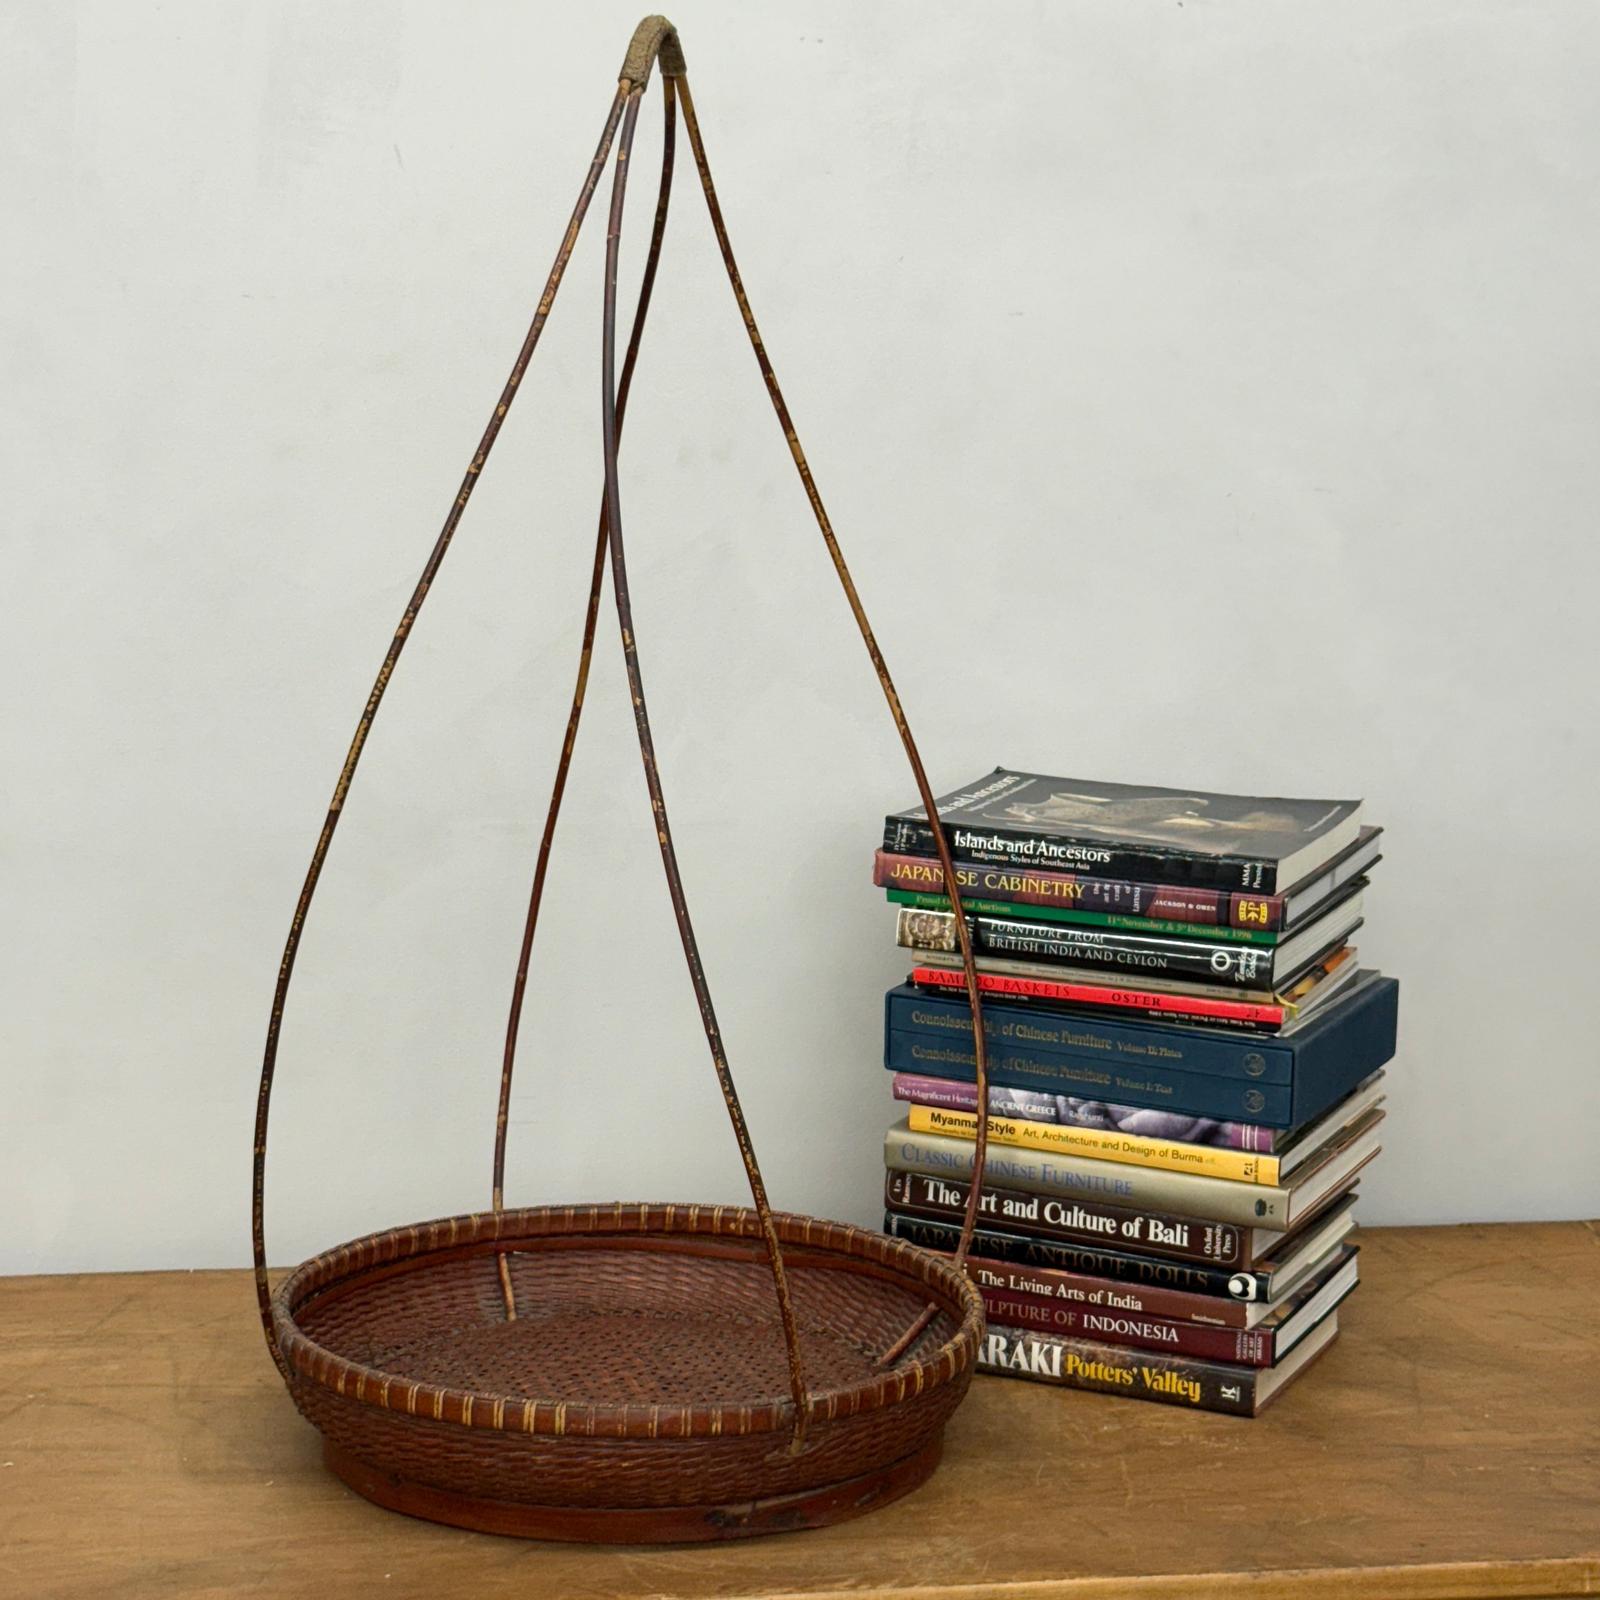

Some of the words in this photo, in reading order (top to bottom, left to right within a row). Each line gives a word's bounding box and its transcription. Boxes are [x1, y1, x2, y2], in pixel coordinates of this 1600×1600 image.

[954, 831, 1004, 852] Islands
[1006, 838, 1034, 855] and
[1036, 840, 1111, 863] Ancestors
[971, 850, 1009, 862] Indigenous
[1010, 854, 1031, 864] Styles
[1032, 857, 1040, 865] of
[1040, 857, 1075, 869] Southeast
[1076, 863, 1090, 871] Asia
[891, 863, 979, 887] JAPANSE
[984, 873, 1086, 899] CABINETRY
[1242, 863, 1250, 887] MMA
[1154, 899, 1186, 909] JACKSON
[990, 923, 1063, 939] FURNITURE
[1067, 932, 1104, 945] FROM
[1122, 918, 1163, 931] November
[1166, 923, 1175, 931] &
[1187, 925, 1229, 938] December
[1231, 929, 1252, 939] 1996
[988, 937, 1039, 953] BRITISH
[1043, 946, 1081, 958] INDIA
[1085, 950, 1113, 962] AND
[1116, 952, 1168, 969] CEYLON
[1003, 980, 1070, 997] BASKETS
[1111, 992, 1161, 1007] OSTER
[1002, 1022, 1014, 1035] of
[1015, 1024, 1058, 1043] Chinese
[1061, 1030, 1112, 1050] Furniture
[1116, 1041, 1146, 1055] Volume
[1002, 1055, 1014, 1069] of
[1014, 1057, 1058, 1077] Chinese
[1061, 1064, 1112, 1085] Furniture
[897, 1087, 911, 1096] The
[911, 1089, 952, 1103] Magnificent
[990, 1099, 1024, 1112] ANCIENT
[1025, 1104, 1057, 1116] GREECE
[930, 1112, 977, 1129] Myanma
[987, 1118, 1016, 1135] Style
[1023, 1127, 1038, 1139] Art,
[1042, 1131, 1099, 1147] Architecture
[1101, 1138, 1119, 1151] and
[1122, 1142, 1156, 1158] Design
[1159, 1149, 1169, 1158] of
[1172, 1150, 1204, 1164] Burma
[902, 1142, 964, 1167] CLASSIC
[1041, 1164, 1133, 1196] FURNITURE
[923, 1179, 961, 1206] The
[1003, 1199, 1038, 1220] and
[1043, 1202, 1117, 1234] Culture
[1121, 1216, 1144, 1238] of
[1147, 1219, 1189, 1248] Bali
[911, 1224, 1014, 1254] JAPAESE
[1025, 1242, 1127, 1276] ANTIQUE
[1138, 1262, 1209, 1289] DOLLS
[1203, 1227, 1213, 1254] Oxford
[1213, 1224, 1223, 1261] University
[1222, 1233, 1232, 1254] Press
[978, 1269, 1005, 1286] The
[1009, 1276, 1052, 1297] Living
[1056, 1283, 1085, 1302] Arts
[1088, 1290, 1104, 1304] of
[1107, 1292, 1143, 1311] India
[1054, 1310, 1077, 1326] OF
[1083, 1314, 1179, 1343] INDONESIA
[1065, 1353, 1138, 1385] Potters'
[1142, 1366, 1201, 1403] Valley
